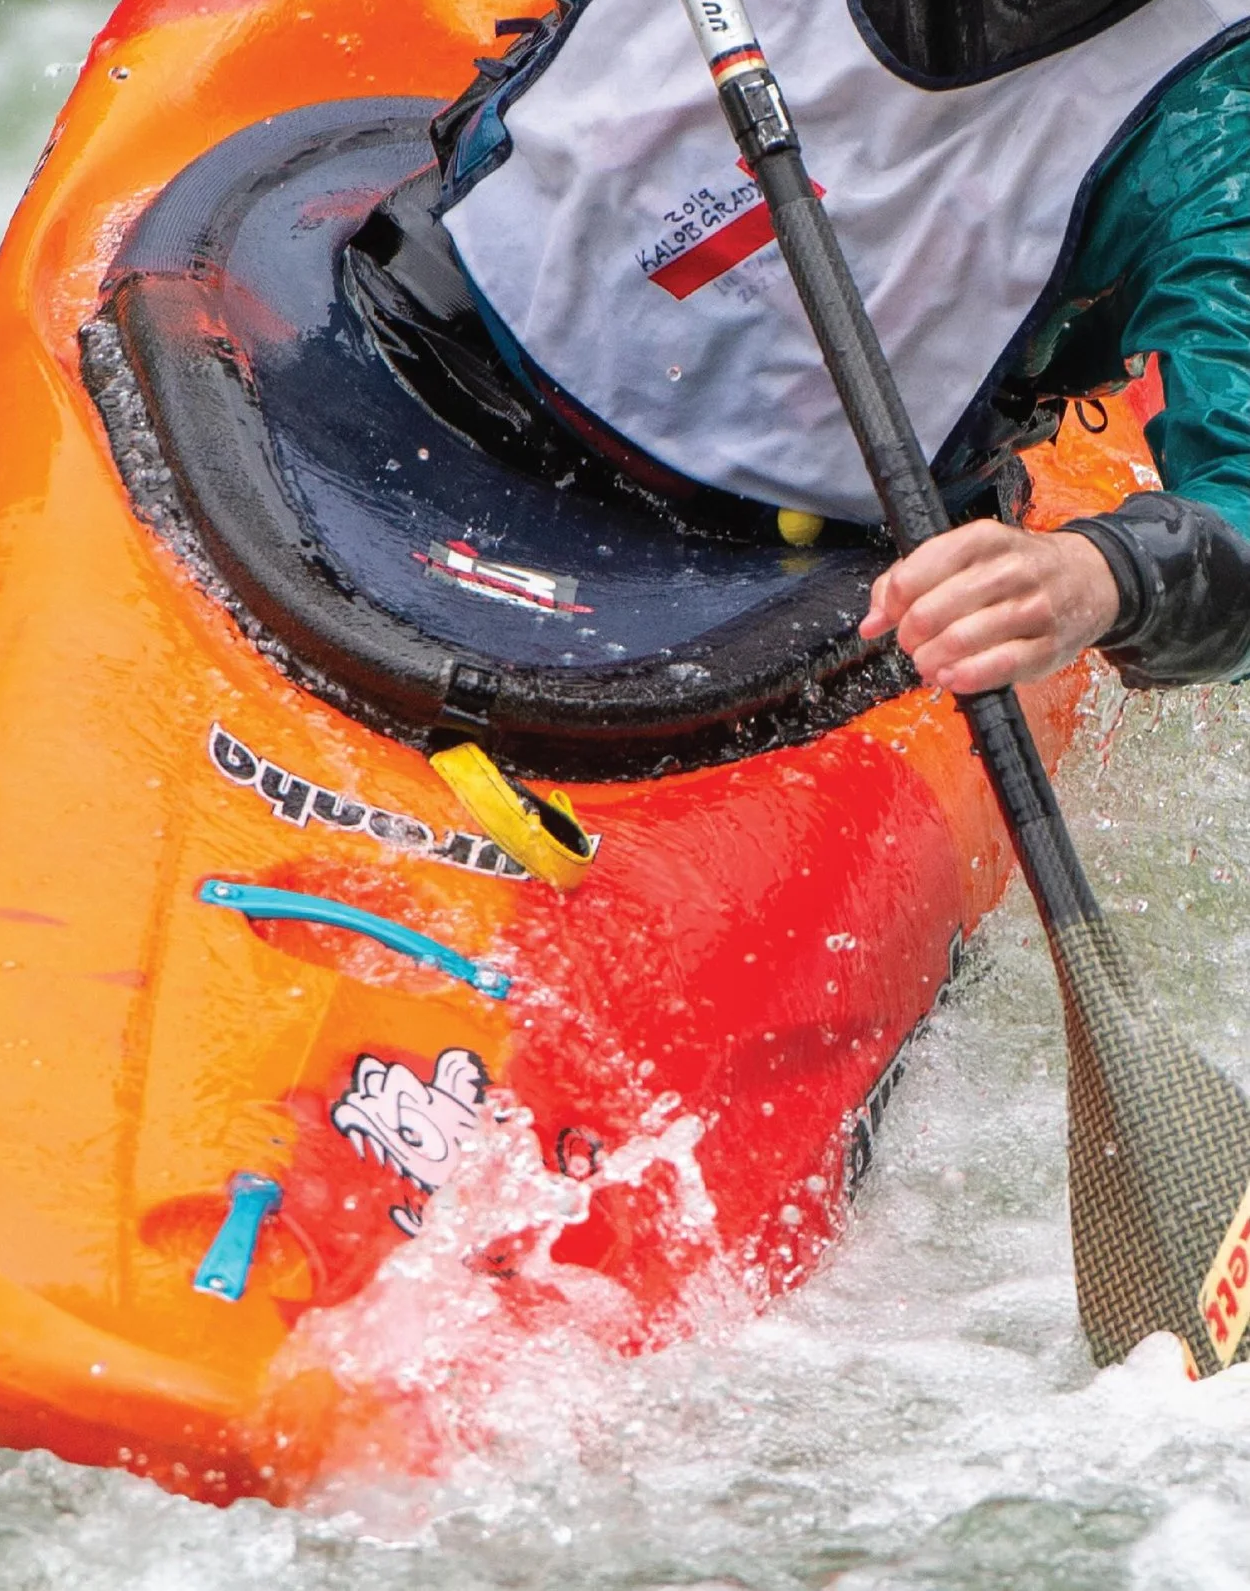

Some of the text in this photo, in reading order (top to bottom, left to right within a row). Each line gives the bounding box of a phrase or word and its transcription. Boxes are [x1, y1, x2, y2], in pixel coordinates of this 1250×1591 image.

[664, 188, 716, 223] 2019
[635, 221, 703, 272] KALOB
[209, 722, 602, 880] yranha
